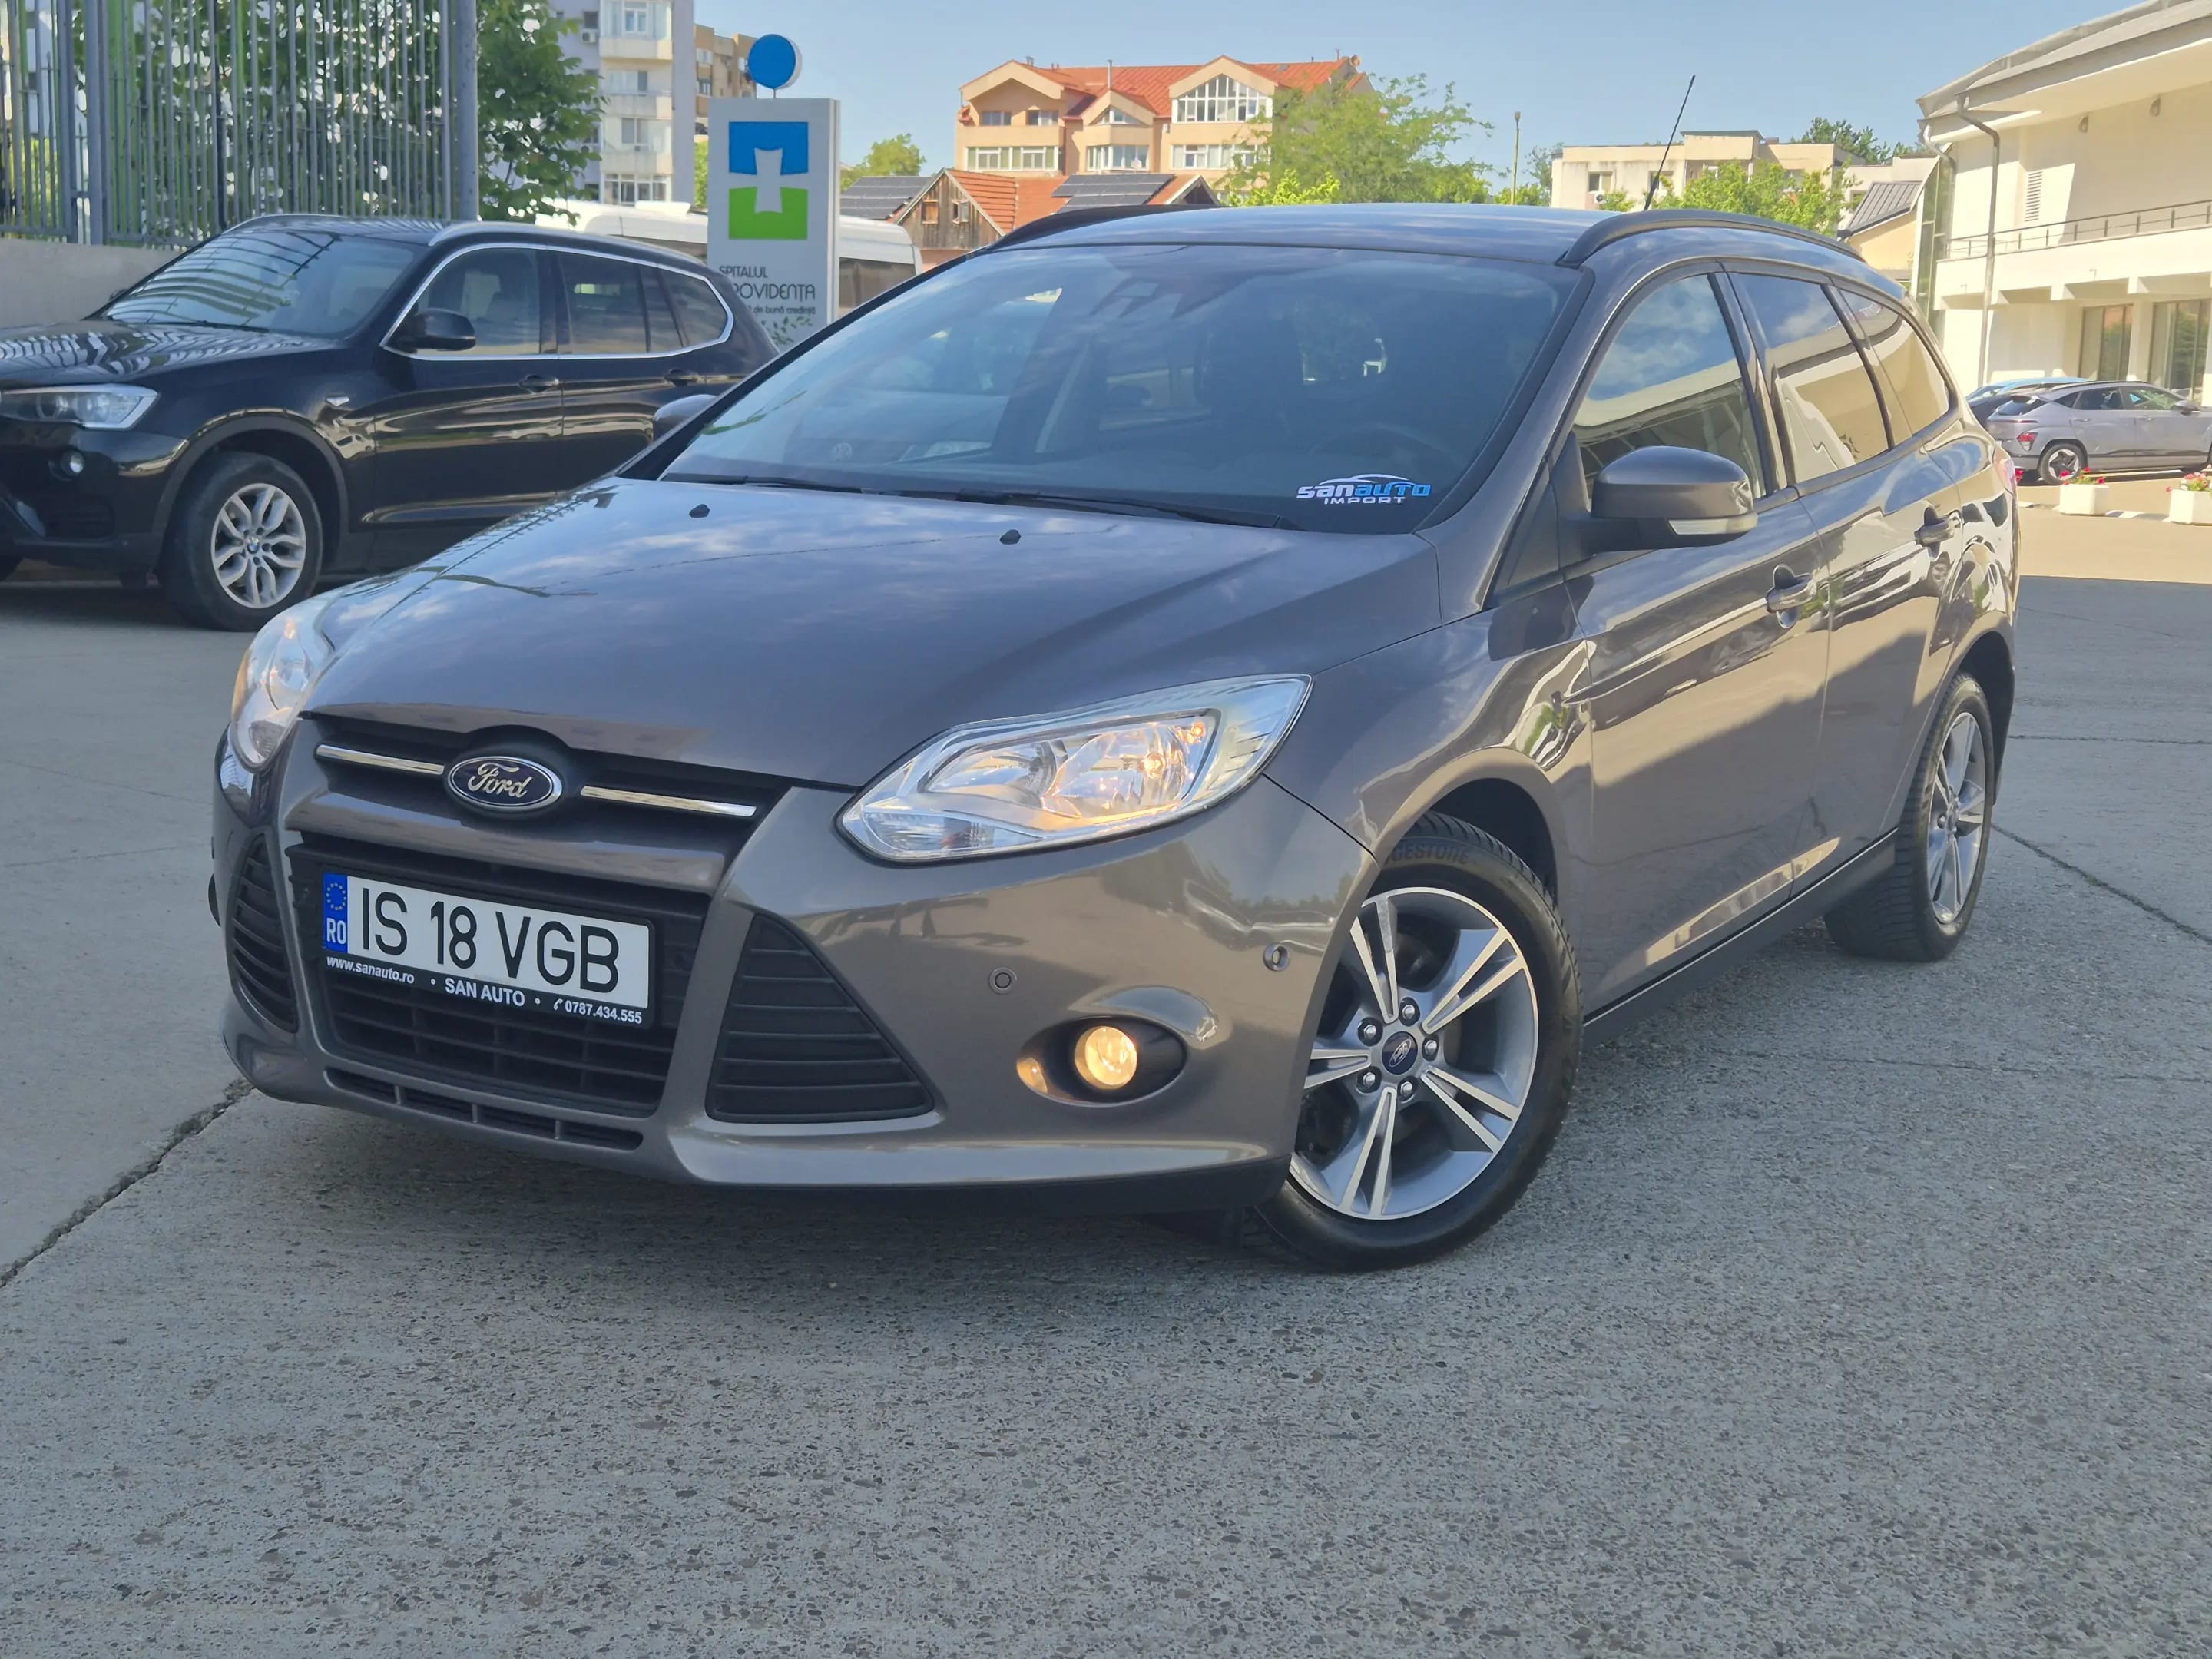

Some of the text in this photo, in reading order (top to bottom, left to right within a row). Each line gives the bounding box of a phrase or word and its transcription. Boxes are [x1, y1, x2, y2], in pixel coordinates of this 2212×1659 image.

[719, 266, 768, 278] SPITALUL
[733, 283, 816, 302] OVIDENȚA
[467, 762, 533, 798] Ford
[326, 917, 346, 945] RO
[362, 888, 619, 994] IS 18 VGB
[326, 956, 643, 1025] www.sanauto.ro SAN AUTO 0787.434.555
